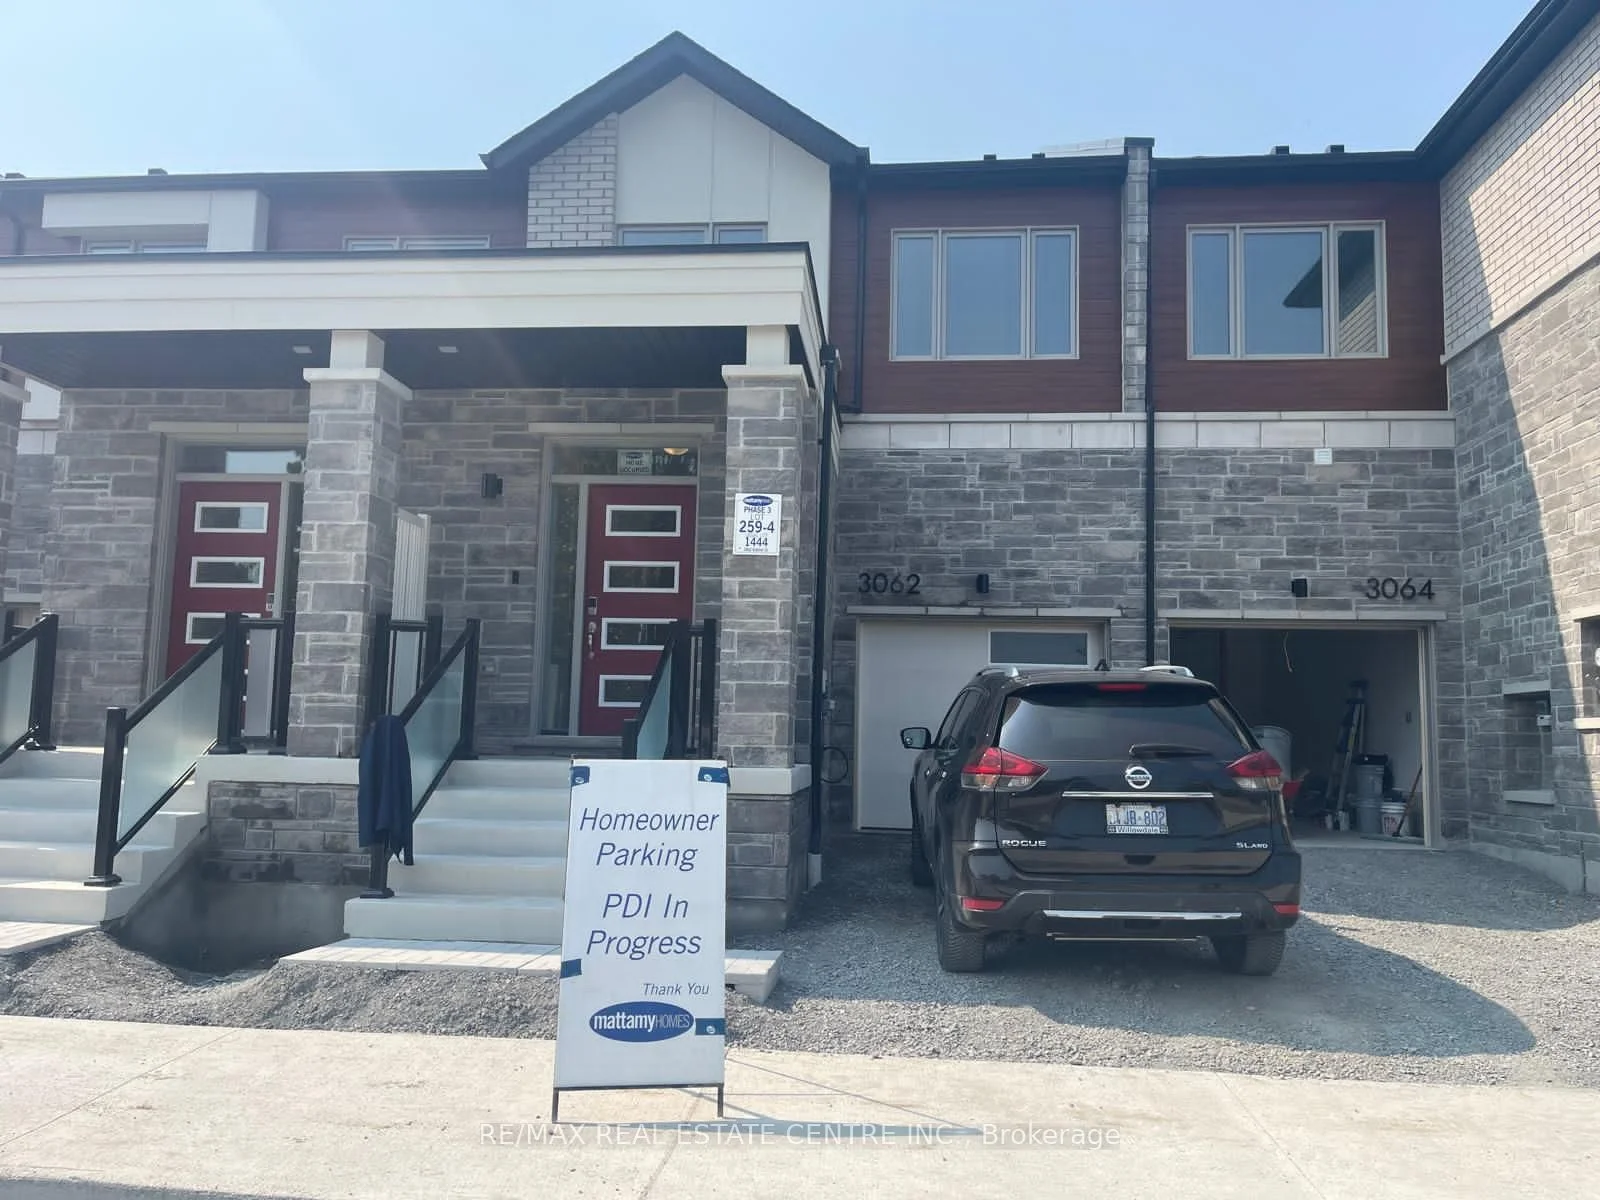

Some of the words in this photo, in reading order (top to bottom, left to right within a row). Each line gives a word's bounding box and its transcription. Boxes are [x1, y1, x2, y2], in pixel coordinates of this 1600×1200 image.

[743, 506, 765, 514] PHASE
[750, 513, 764, 521] LOT
[739, 520, 775, 534] 259-4
[745, 536, 769, 547] 1444
[858, 572, 921, 594] 3062
[1366, 577, 1436, 600] 3064
[579, 807, 720, 832] Homeowner
[1001, 839, 1048, 847] ROGUE
[596, 842, 699, 872] Parking
[602, 893, 653, 919] PDI
[663, 893, 690, 919] In
[586, 929, 703, 961] Progress
[643, 982, 683, 996] Thank
[687, 982, 710, 996] You
